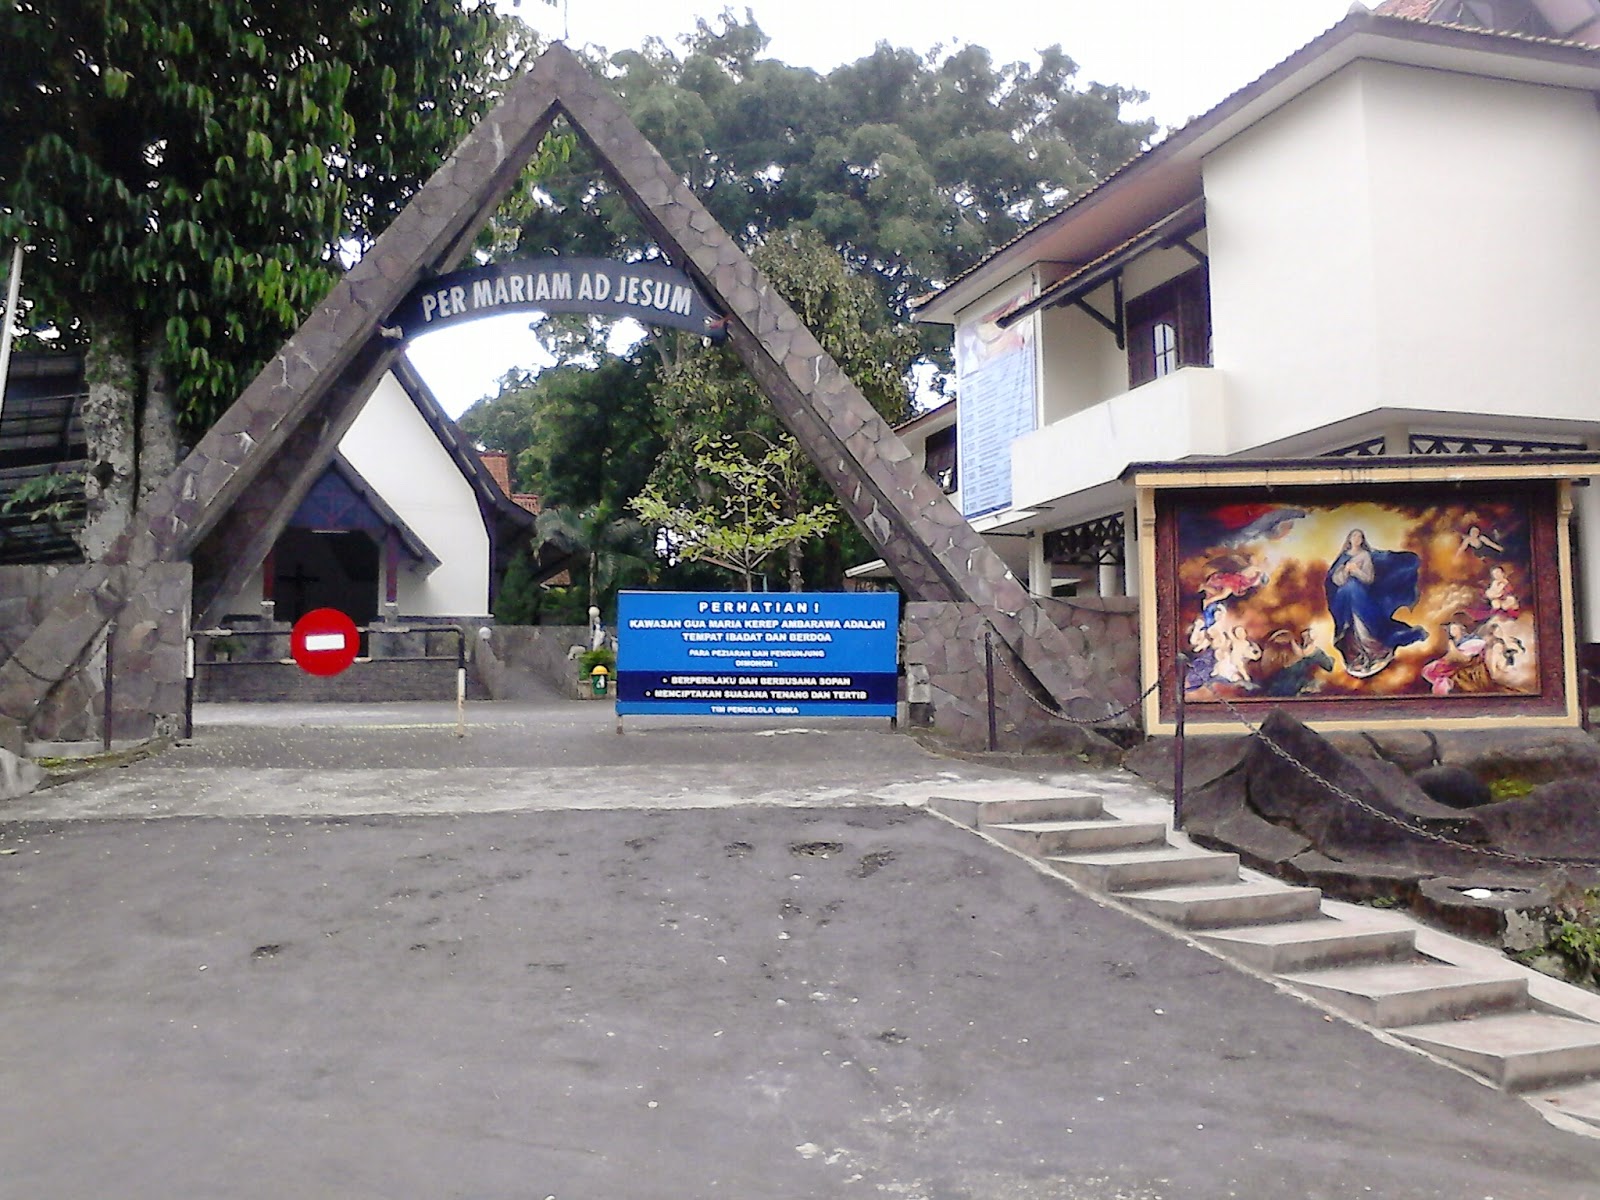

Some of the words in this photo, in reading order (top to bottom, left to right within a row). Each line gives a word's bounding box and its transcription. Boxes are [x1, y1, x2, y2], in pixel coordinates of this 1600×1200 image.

[422, 285, 467, 322] PER
[472, 273, 572, 309] MARIAM
[578, 274, 610, 301] AD
[614, 277, 692, 316] JESUM
[699, 601, 808, 613] PERHATIAN
[629, 619, 681, 628] KAWASAN
[684, 619, 706, 628] GUA
[708, 619, 742, 628] MARIA
[744, 620, 779, 628] KEREP
[781, 620, 841, 628] AMBARAWA
[843, 620, 885, 629] ADALAH
[682, 632, 723, 641] TEMPAT
[725, 632, 763, 641] IBADAT
[765, 633, 786, 641] DAN
[789, 633, 832, 642] BERDOA
[689, 649, 710, 657] PARA
[711, 649, 751, 657] PEZIARAH
[671, 676, 736, 685] BERPERILAKU
[738, 677, 758, 685] DAN
[760, 677, 817, 685] BERBUSANA
[819, 677, 850, 685] SOPAN
[654, 689, 721, 698] MENCIPTAKAN
[724, 690, 768, 698] SUASANA
[770, 690, 809, 699] TENANG
[811, 690, 830, 699] DAN
[833, 690, 867, 699] TERTIB
